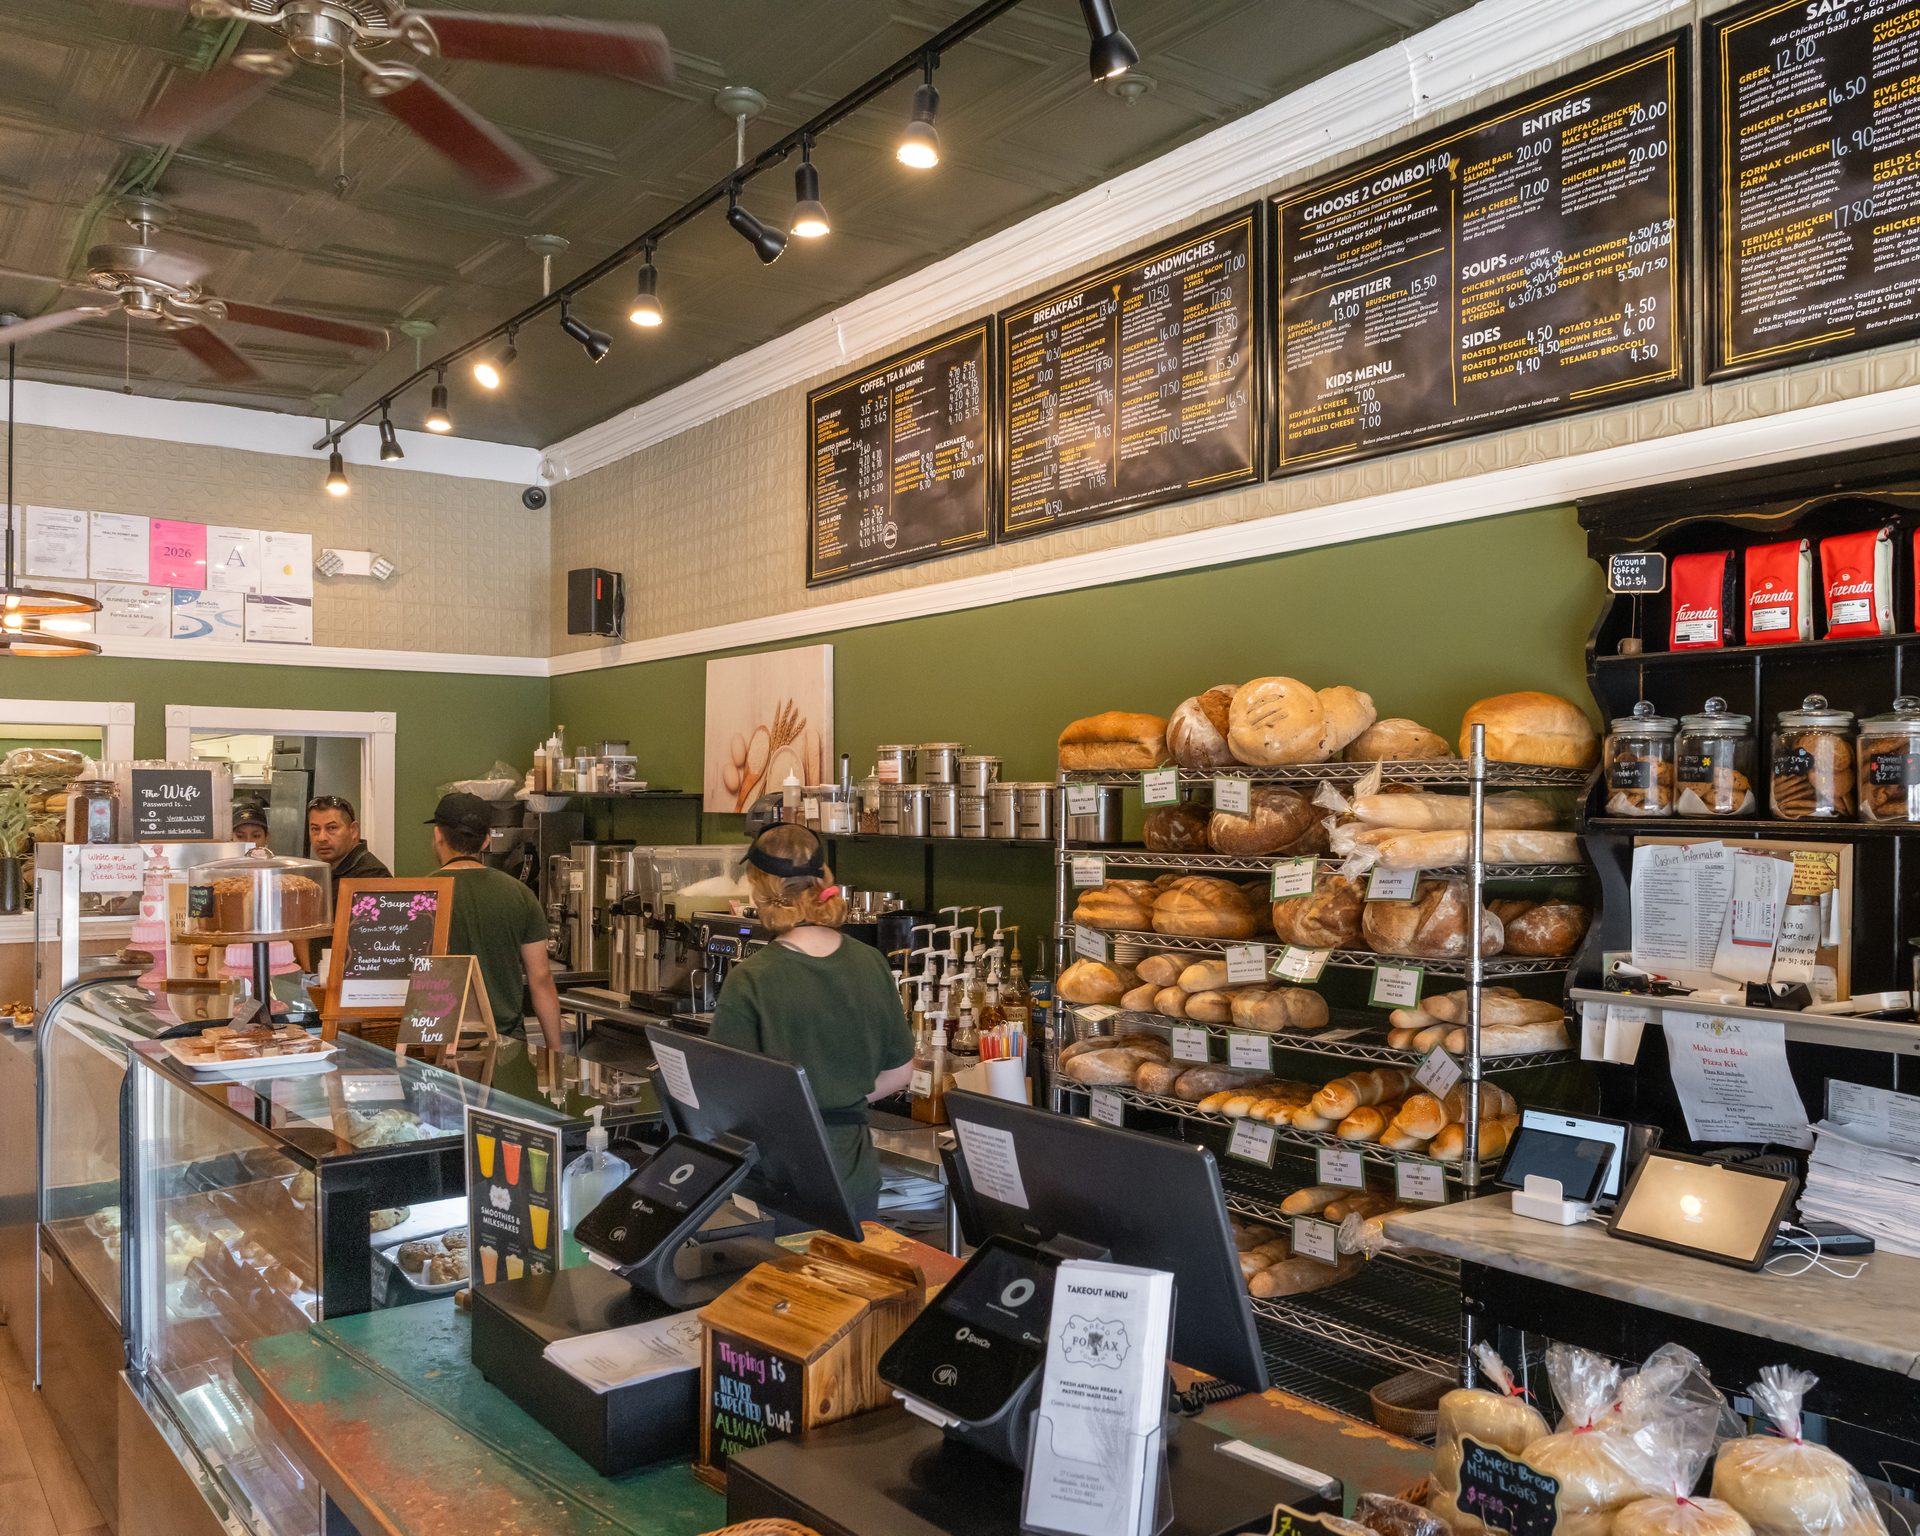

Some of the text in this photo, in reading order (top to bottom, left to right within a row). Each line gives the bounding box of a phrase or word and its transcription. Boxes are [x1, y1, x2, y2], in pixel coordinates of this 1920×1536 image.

[1770, 34, 1786, 46] Add
[1790, 21, 1823, 38] Chicken
[1826, 10, 1846, 25] 6.00
[1855, 5, 1863, 13] or
[1739, 40, 1815, 84] GREEK 12.00
[1739, 81, 1756, 93] Salad
[1772, 65, 1802, 79] kalamata
[1874, 83, 1897, 98] FIVE
[1522, 97, 1591, 137] ENTRÉES
[1630, 102, 1666, 126] 20.00
[1741, 76, 1866, 135] CHICKEN CAESAR 16.50
[1563, 103, 1640, 138] BUFFALO CHICKEN
[1464, 138, 1551, 175] LEMON BASIL 20.00
[1562, 141, 1667, 185] CHICKEN PARM 20.00
[1741, 127, 1873, 179] FORNAX CHICKEN 16.90
[1874, 154, 1911, 172] FIELDS
[1464, 166, 1494, 183] SALMON
[1741, 174, 1767, 189] FARM
[1873, 166, 1903, 181] GOAT
[1304, 152, 1450, 220] CHOOSE 2 COMBO 14.00
[1316, 204, 1411, 244] HALF SANDWICH HALF WRAP
[1742, 196, 1873, 247] TERIYAKI CHICKEN 17.80
[1557, 252, 1580, 265] CLAM
[1583, 238, 1627, 256] CHOWDER
[1742, 228, 1813, 257] LETTUCE WRAP
[1144, 241, 1215, 279] SANDWICHES
[1462, 248, 1549, 279] SOUPS CUP BOWL
[1184, 271, 1203, 282] TURKEY
[1205, 263, 1223, 274] BACON
[1462, 269, 1523, 293] CHICKEN VEGGIE
[1123, 294, 1143, 306] CHICKEN
[1329, 277, 1391, 307] APPETIZER
[1366, 275, 1437, 307] BRUSCHETTA 15.50
[1034, 294, 1083, 324] BREAKFAST
[1335, 304, 1359, 322] 13.00
[1560, 297, 1656, 335] POTATO SALAD 4.50
[1827, 298, 1911, 324] Creamy Caesar Ranch
[1123, 342, 1143, 353] CHICKEN
[1144, 337, 1157, 345] PARM
[1462, 327, 1500, 349] SIDES
[1462, 325, 1552, 360] ROASTED VEGGIE 4.50
[860, 360, 924, 394] COFFEE, TEA & MORE
[1326, 360, 1391, 389] KIDS MENU
[1122, 397, 1142, 407] CHICKEN
[1144, 392, 1158, 400] PESTO
[895, 450, 919, 463] SMOOTHIES
[164, 546, 192, 559] 2026
[225, 546, 246, 568] A
[1613, 556, 1646, 567] Ground
[1749, 589, 1794, 605] Fazenda
[1829, 580, 1873, 597] Fazenda
[1676, 604, 1718, 621] Fazenda
[141, 784, 201, 801] The Wifi
[1654, 850, 1723, 867] Cashier Information
[380, 895, 410, 912] Soups
[373, 941, 401, 951] Quiche
[411, 1016, 440, 1028] now
[421, 1027, 444, 1043] here
[1692, 1043, 1749, 1057] Make and Bake
[1702, 1058, 1737, 1068] Pizza Kit
[481, 1206, 515, 1224] SMOOTHIES
[482, 1217, 520, 1234] MILKSHAKES
[1067, 1284, 1129, 1299] TAKEOUT MENU
[719, 1342, 786, 1384] Tipping is
[720, 1375, 752, 1401] NEVER
[714, 1391, 793, 1434] EXPECTED but
[1466, 1460, 1493, 1484] Mini
[1499, 1476, 1537, 1505] Loafs
[1472, 1448, 1556, 1494] Sweet Bread
